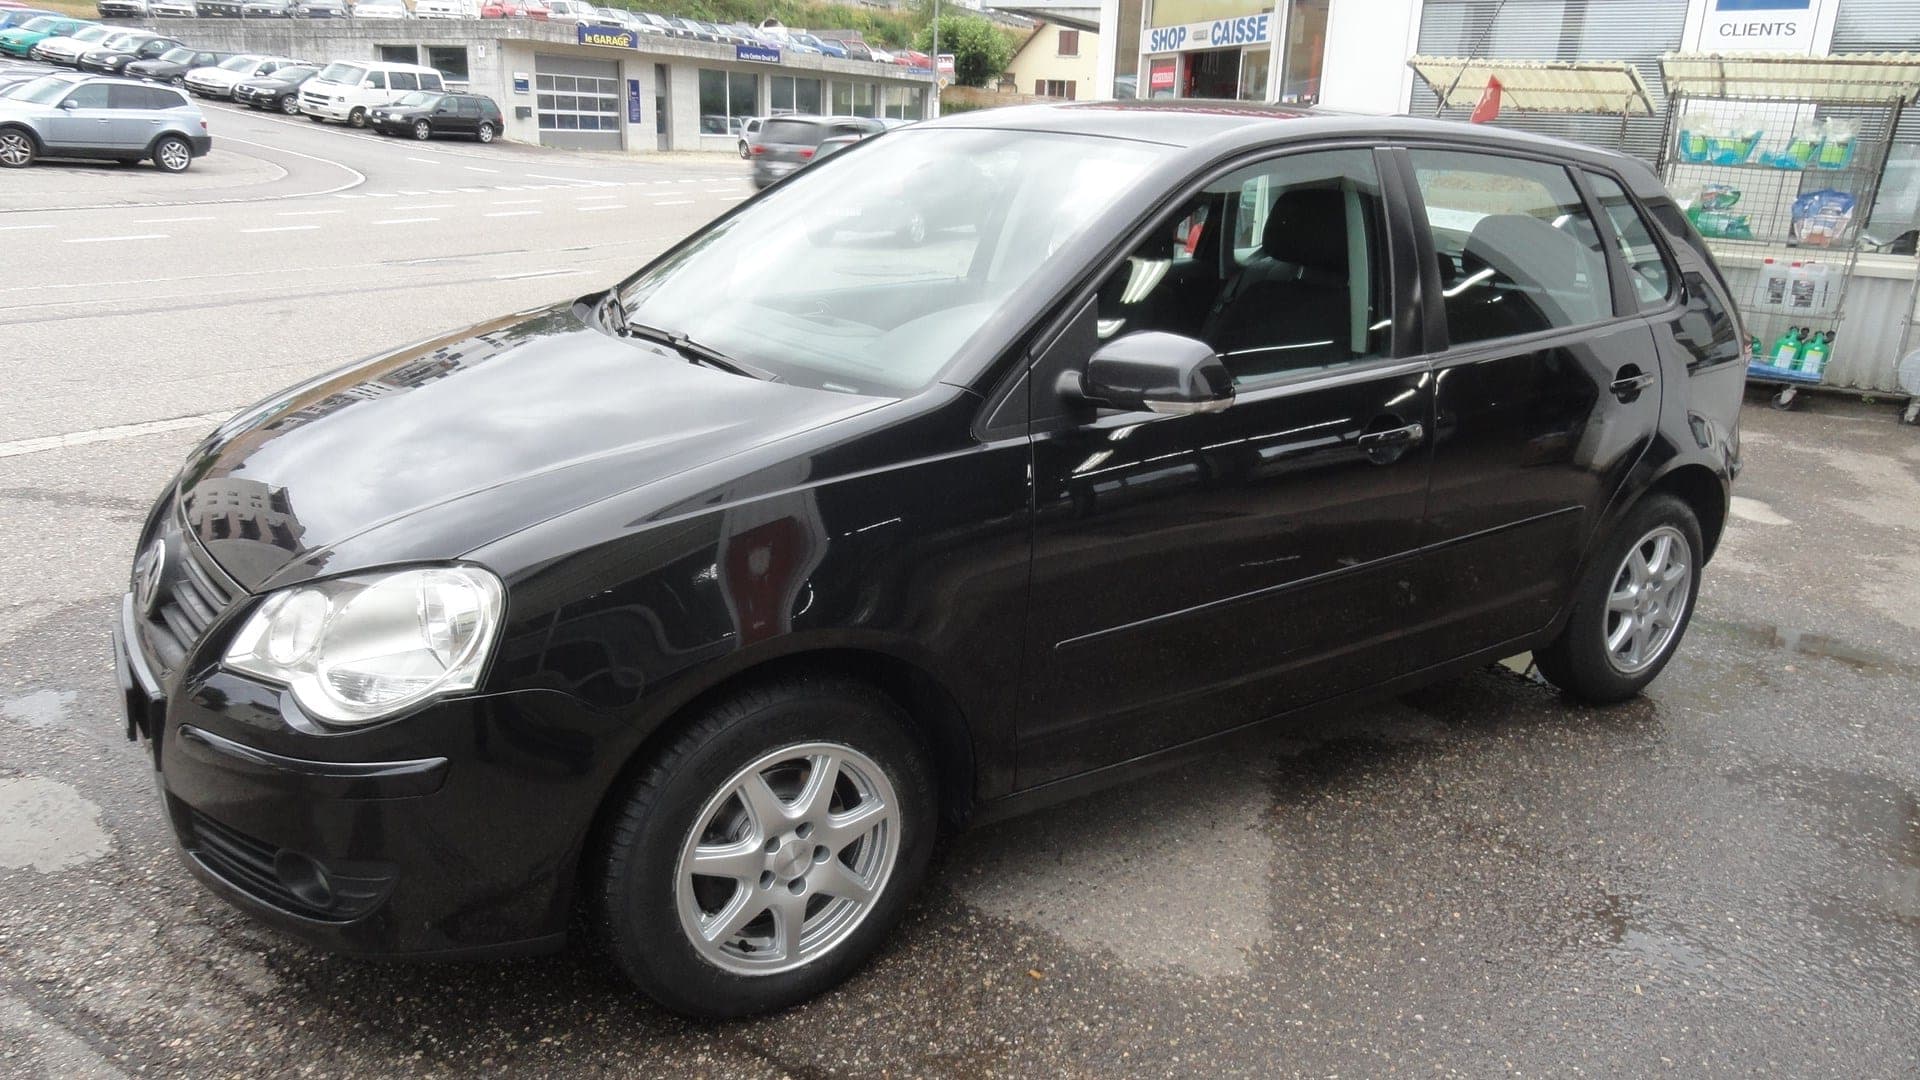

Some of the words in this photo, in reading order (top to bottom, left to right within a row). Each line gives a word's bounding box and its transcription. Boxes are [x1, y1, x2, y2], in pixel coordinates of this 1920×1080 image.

[1151, 26, 1187, 52] SHOP
[1211, 15, 1268, 46] CAISSE
[1719, 22, 1797, 37] CLIENTS
[584, 33, 593, 43] le
[593, 34, 630, 47] GARAGE
